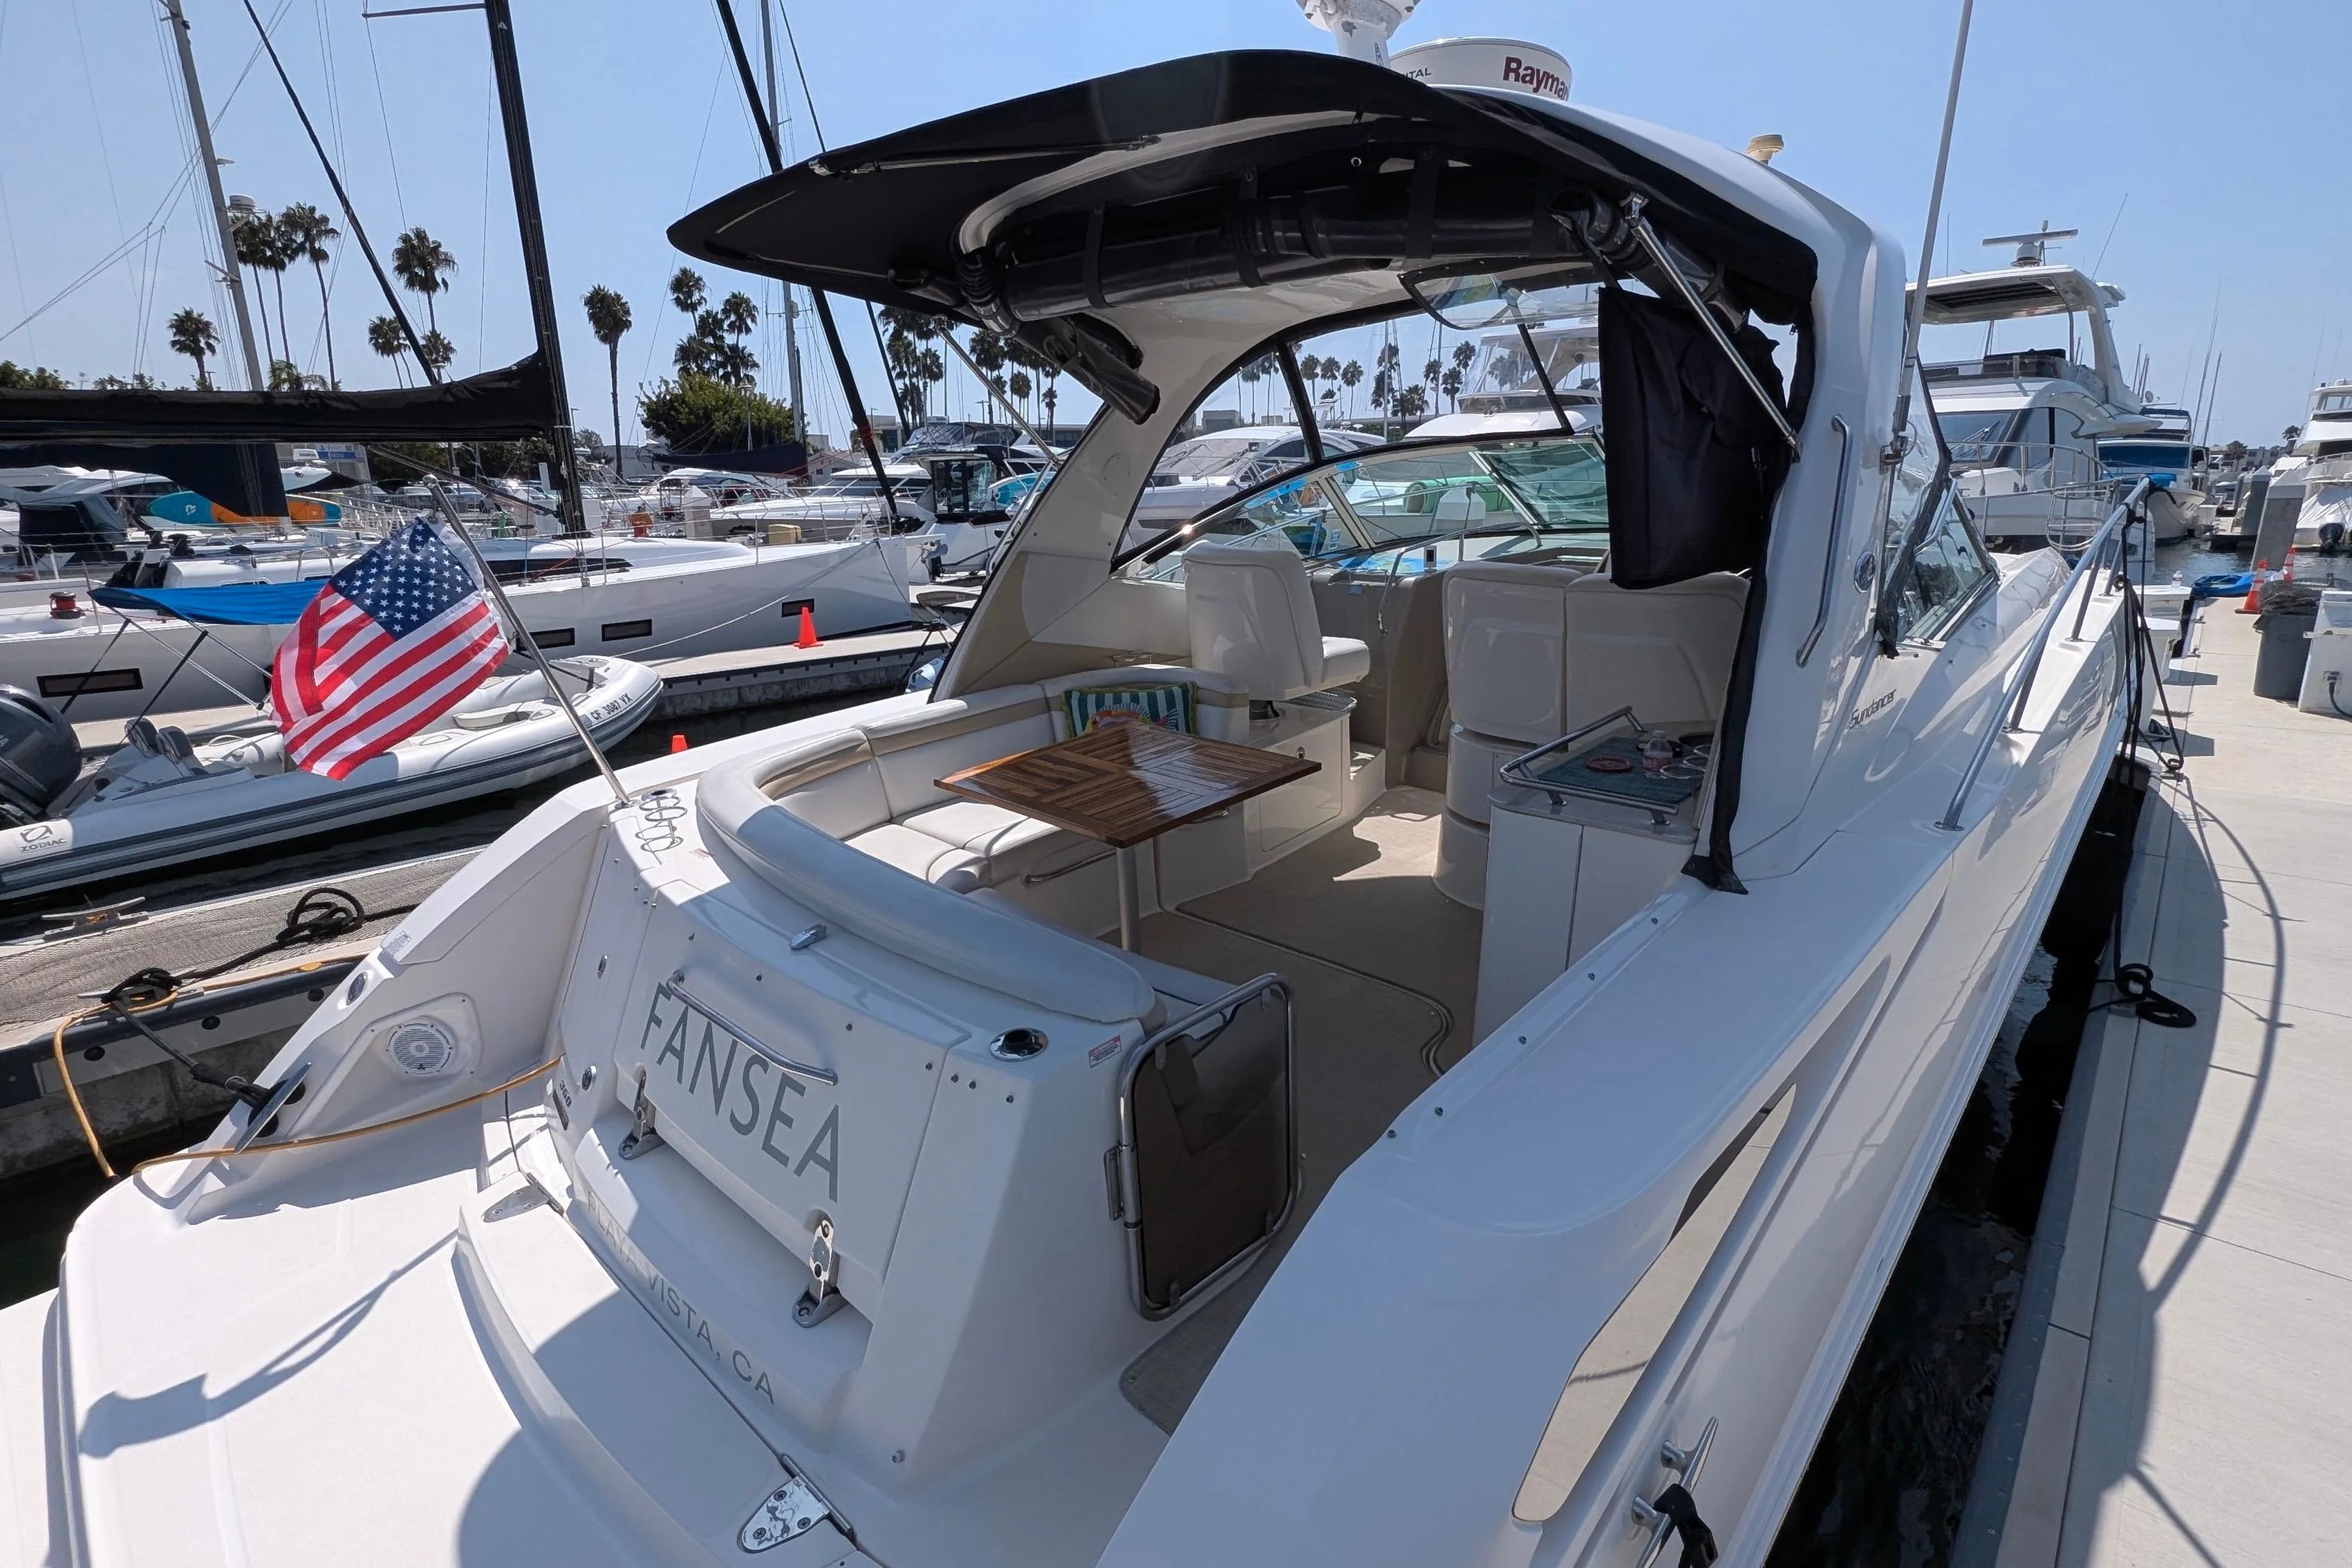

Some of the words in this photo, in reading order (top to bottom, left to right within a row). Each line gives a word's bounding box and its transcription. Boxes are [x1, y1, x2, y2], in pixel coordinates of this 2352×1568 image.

[590, 709, 602, 720] CF
[602, 700, 622, 715] 3087
[618, 693, 634, 705] VX
[1849, 689, 1896, 729] Sundancer
[21, 838, 67, 852] ZODIAC
[640, 982, 839, 1203] FANSEA
[588, 1190, 640, 1274] PLAYA
[646, 1262, 720, 1361] VISTA,
[732, 1350, 774, 1405] CA
